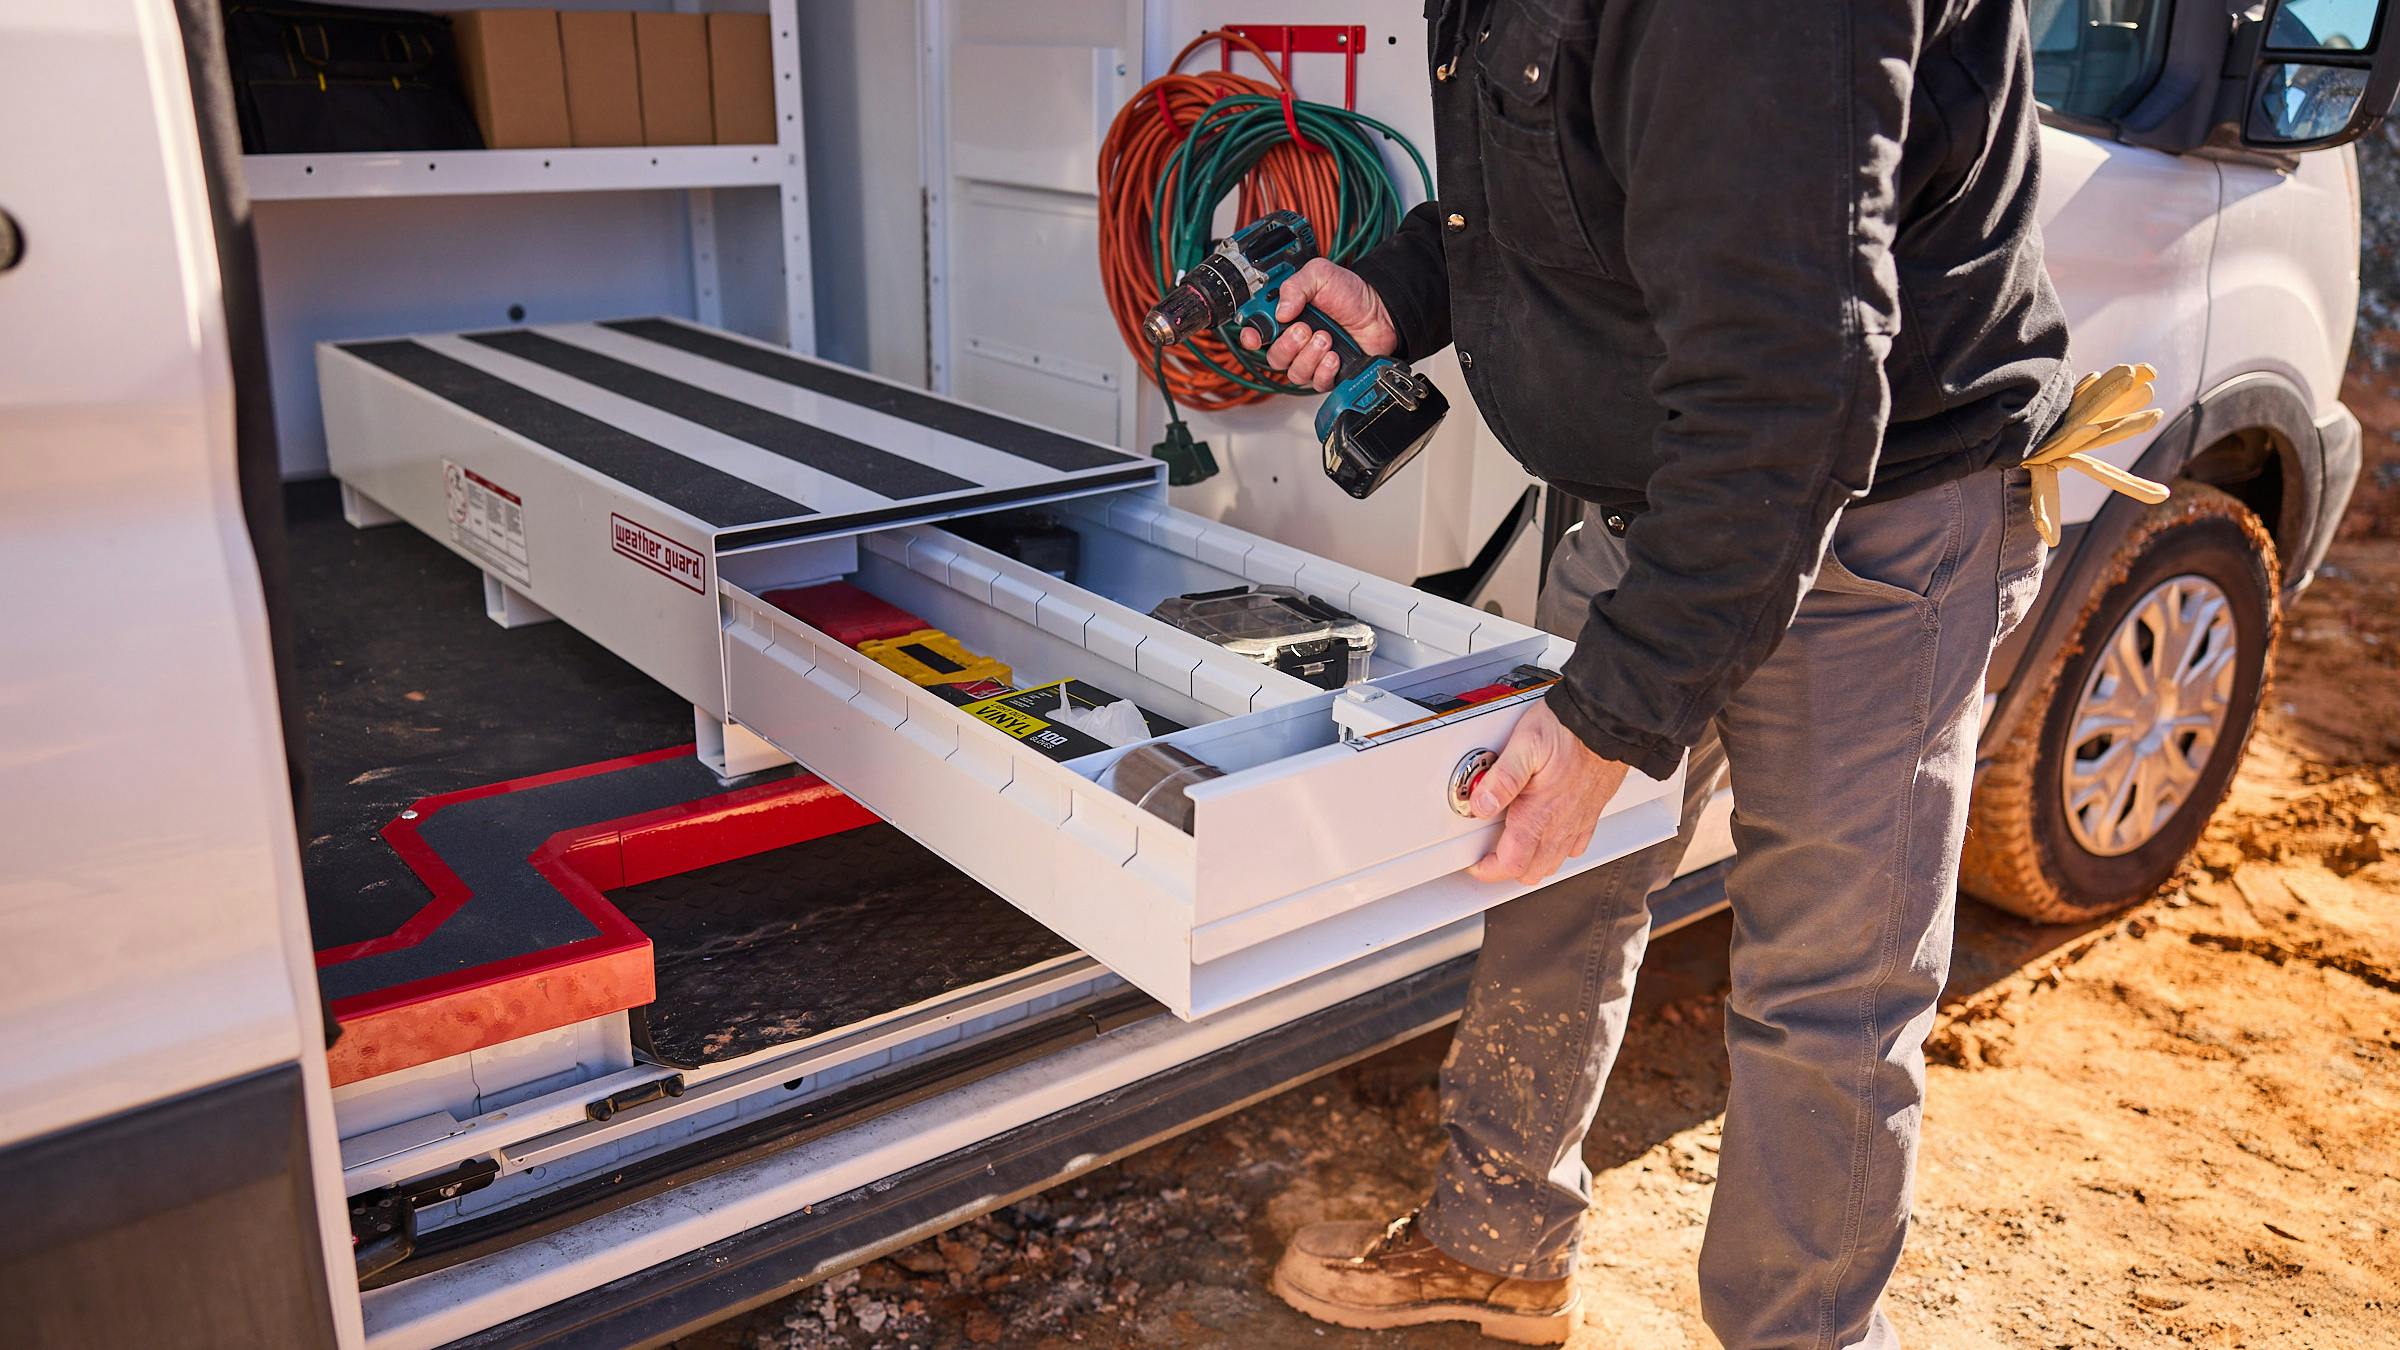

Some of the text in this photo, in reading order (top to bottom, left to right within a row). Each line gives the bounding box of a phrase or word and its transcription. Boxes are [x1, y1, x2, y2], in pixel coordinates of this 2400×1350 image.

[616, 524, 700, 580] weather guard
[976, 706, 1031, 735] VINYL
[1038, 730, 1068, 746] 100
